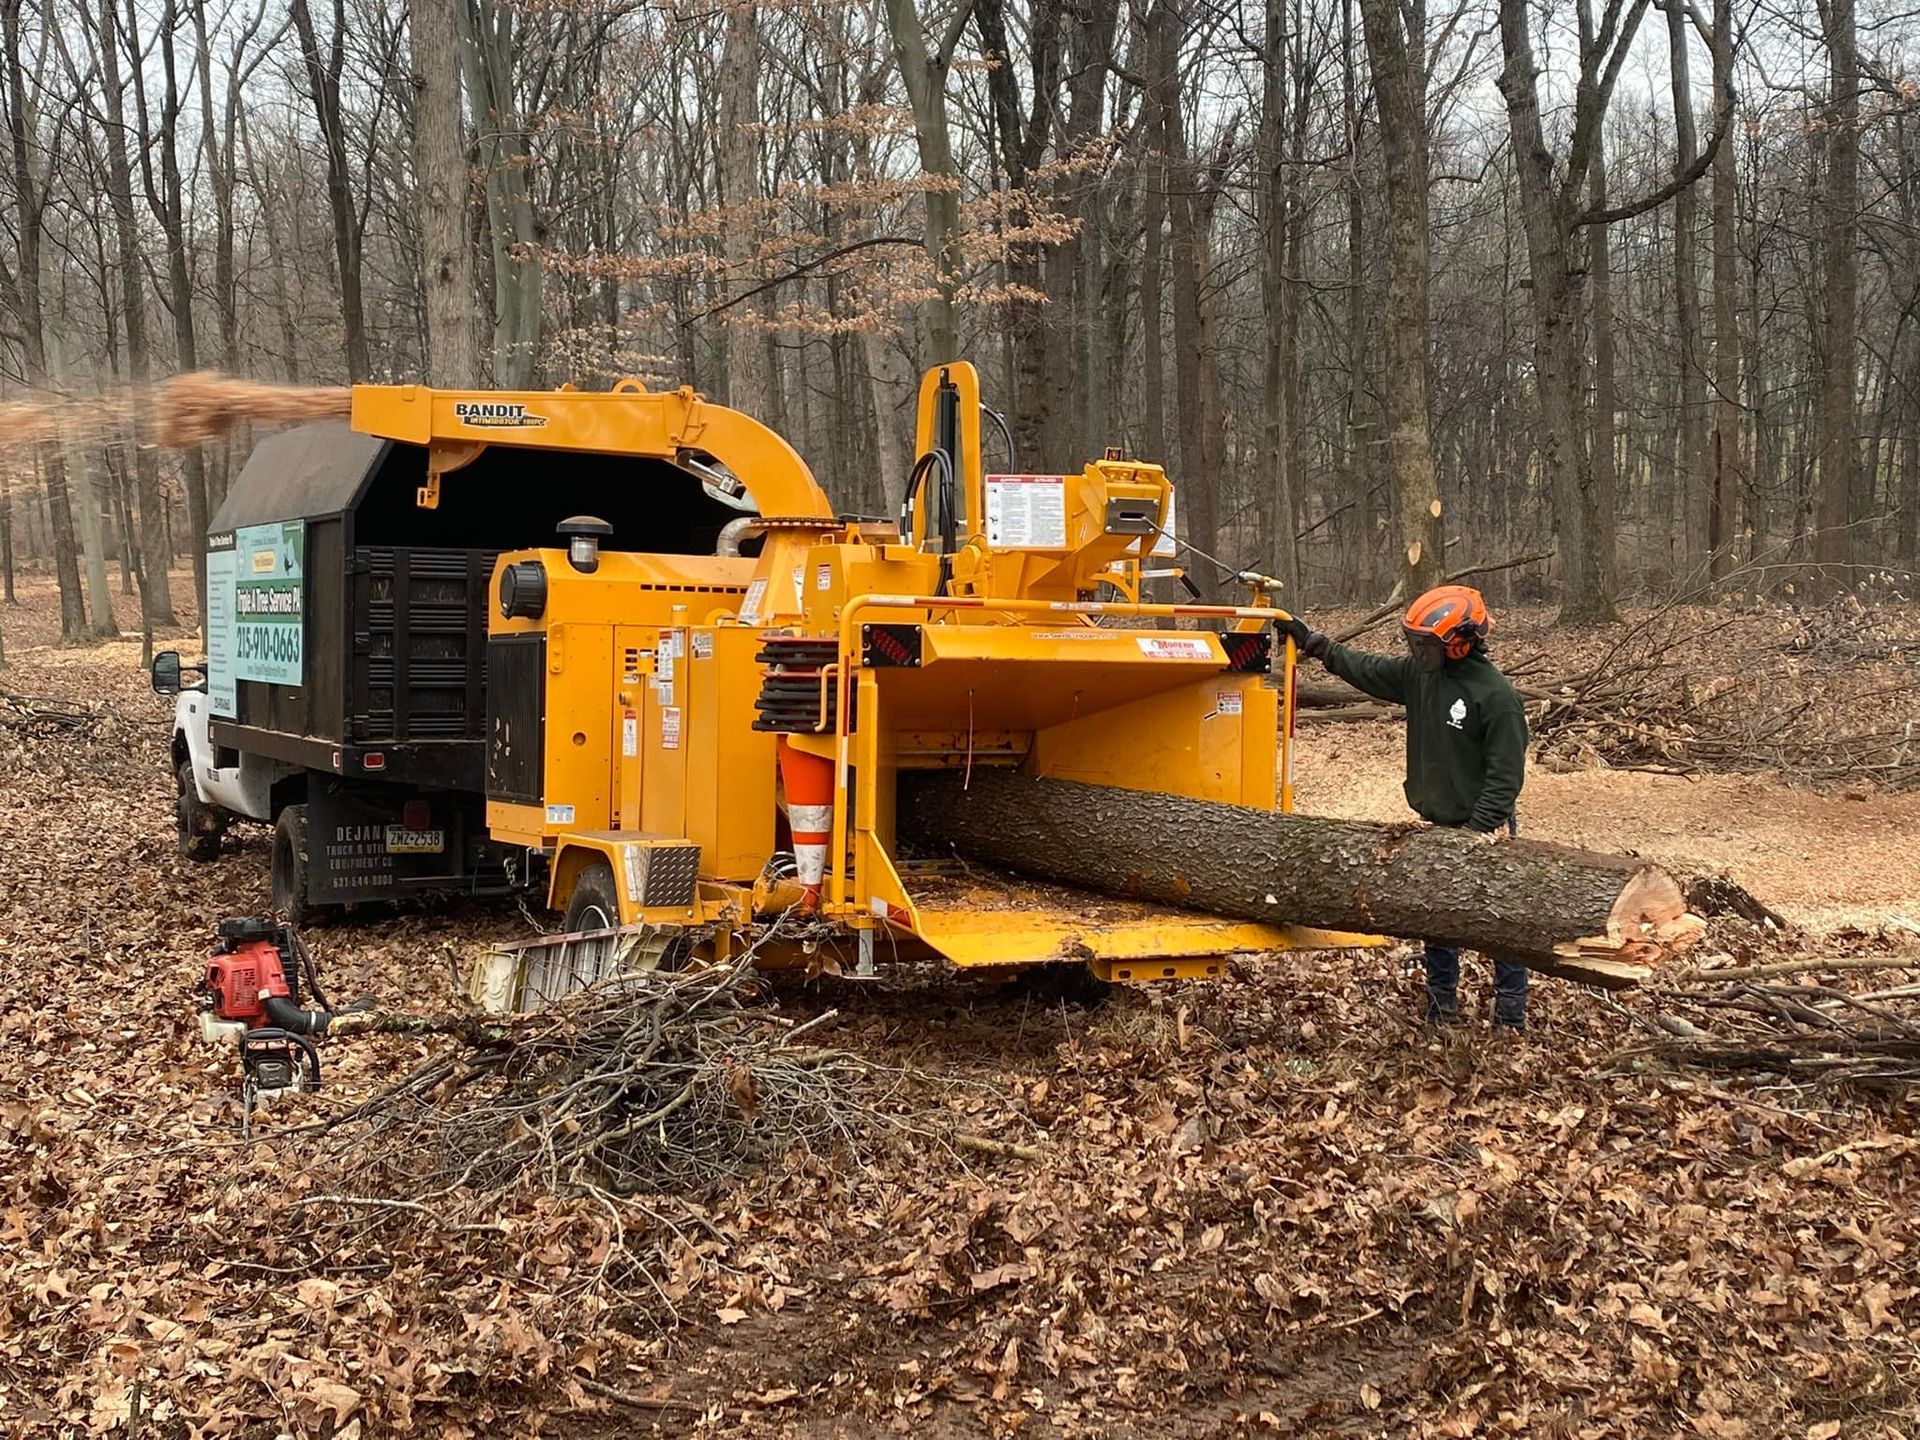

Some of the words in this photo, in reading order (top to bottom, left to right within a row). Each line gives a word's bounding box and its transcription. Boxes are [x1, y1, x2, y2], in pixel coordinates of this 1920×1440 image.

[456, 403, 525, 417] BANDIT
[237, 588, 251, 617] Triple
[256, 588, 269, 612] Tree
[269, 586, 292, 613] Service
[236, 626, 300, 663] 215-910-0663
[326, 845, 354, 856] TRUCK
[366, 843, 385, 855] UTIL
[330, 857, 378, 870] EQUIPMENT
